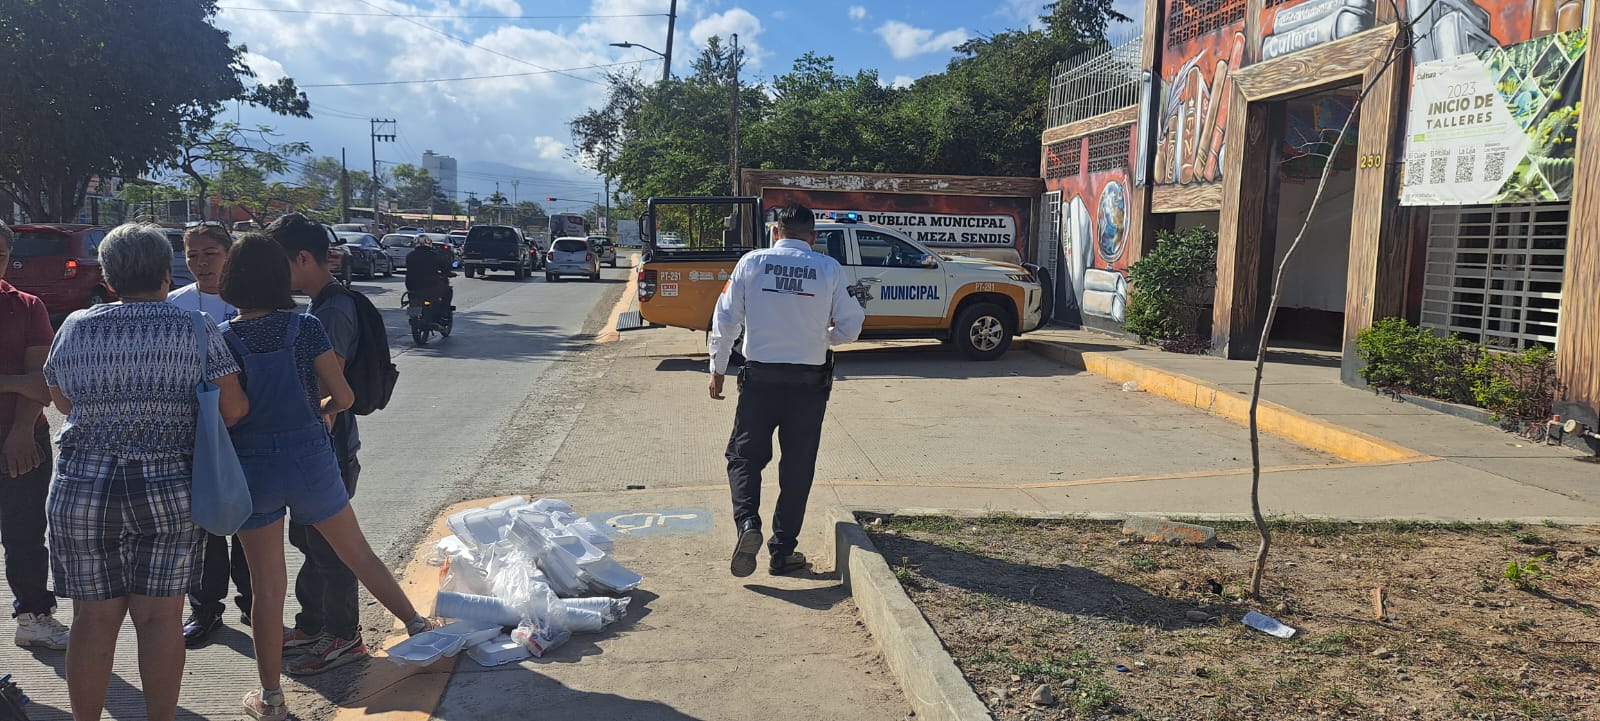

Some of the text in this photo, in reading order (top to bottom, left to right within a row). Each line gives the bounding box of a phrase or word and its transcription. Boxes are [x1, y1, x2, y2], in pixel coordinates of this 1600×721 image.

[1417, 72, 1436, 80] Cultura
[1448, 81, 1476, 98] 2023
[1428, 93, 1494, 115] INICIO DE
[1427, 112, 1492, 129] TALLERES
[1360, 154, 1381, 168] 250
[868, 213, 928, 226] PÚBLICA
[930, 217, 1006, 228] MUNICIPAL
[917, 232, 957, 242] MEZA
[961, 232, 1011, 243] SENDIS
[764, 263, 817, 280] POLICÍA
[775, 276, 803, 292] VIAL
[880, 285, 940, 300] MUNICIPAL
